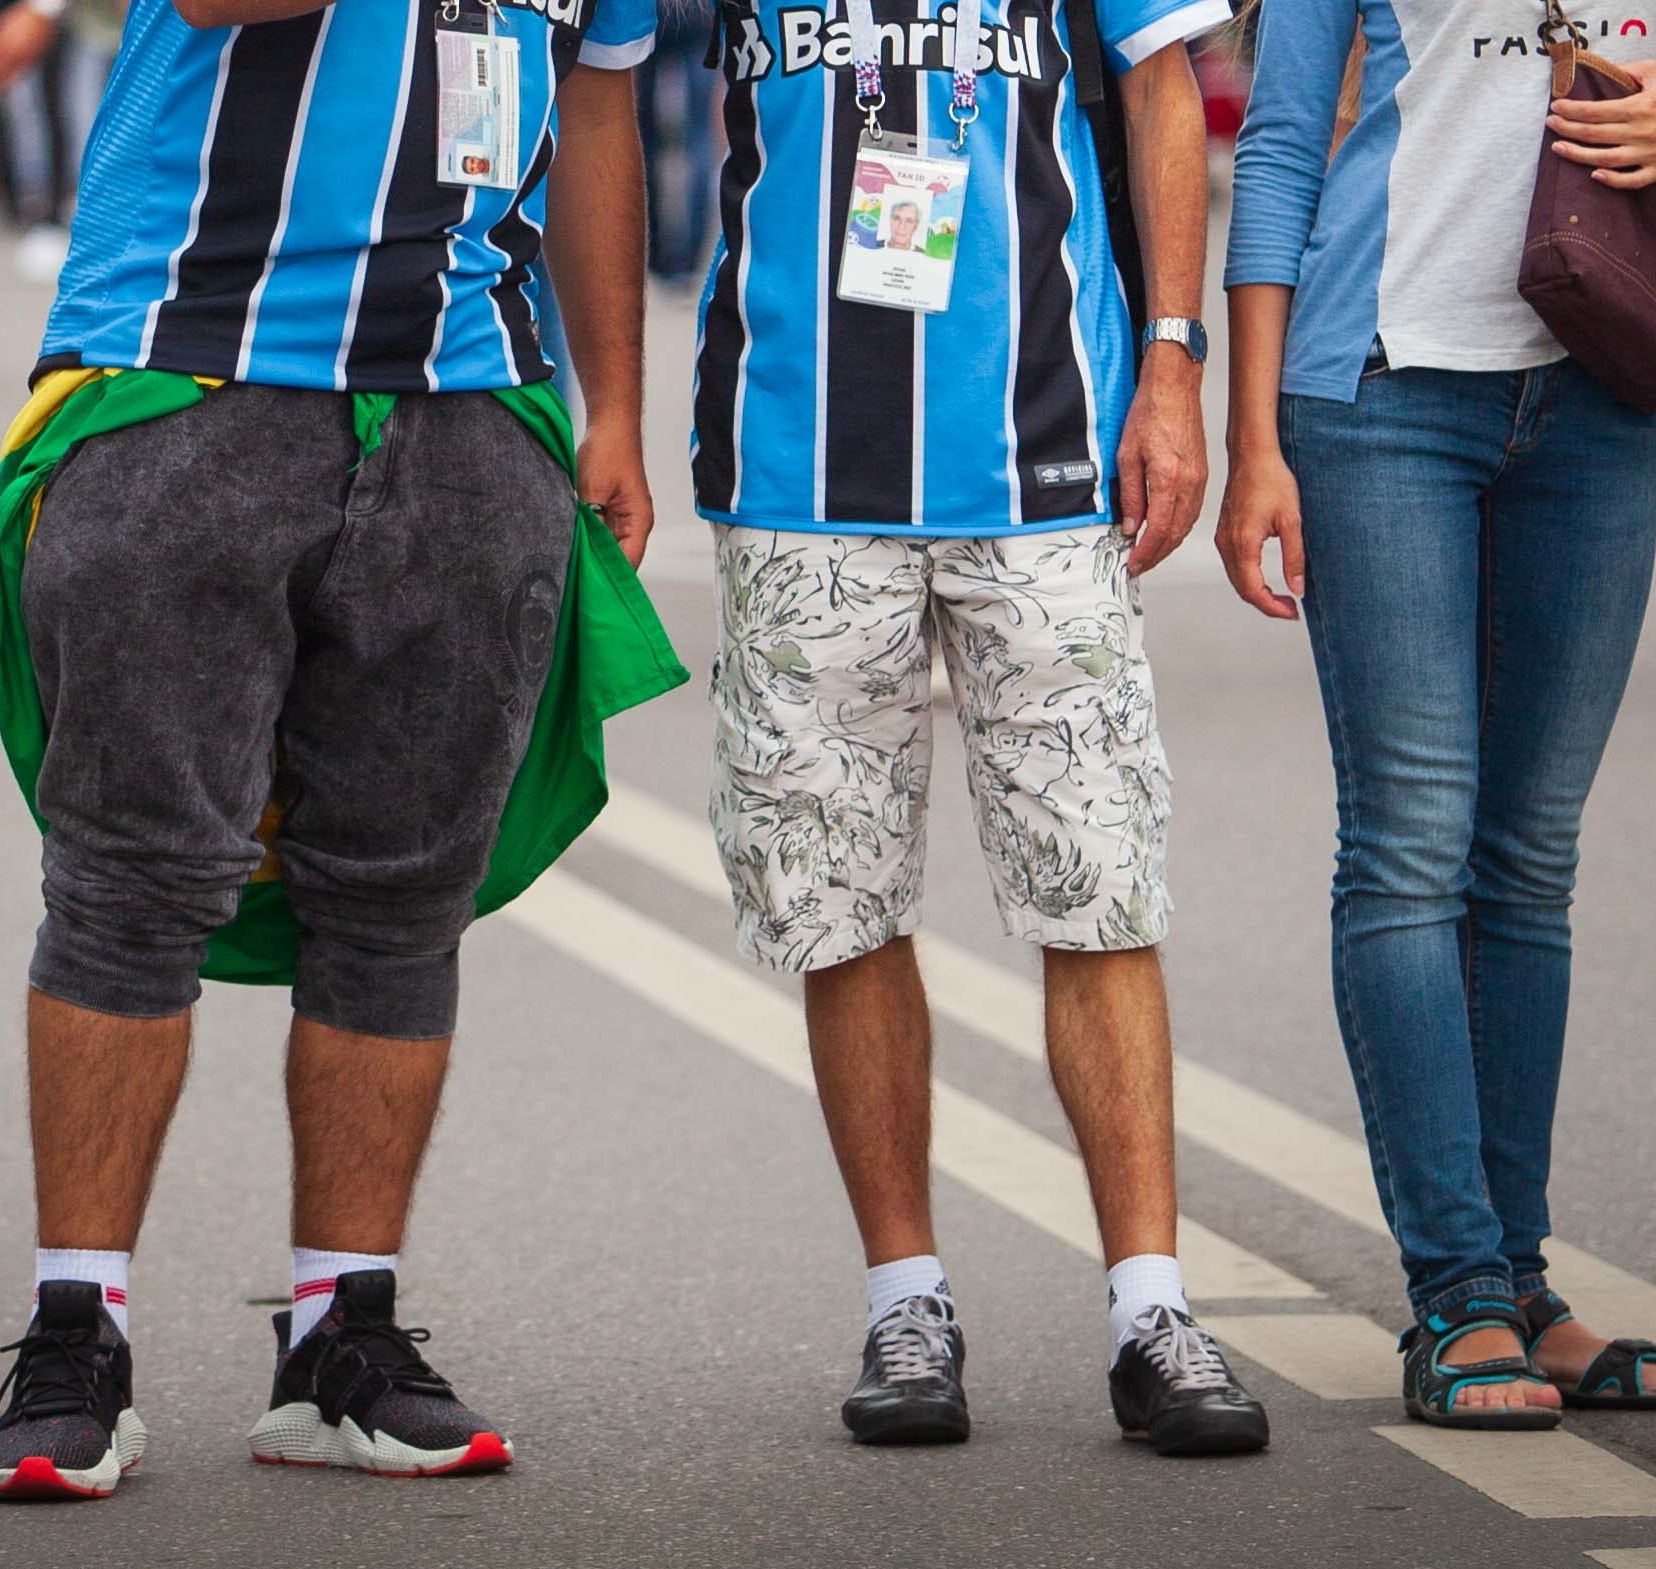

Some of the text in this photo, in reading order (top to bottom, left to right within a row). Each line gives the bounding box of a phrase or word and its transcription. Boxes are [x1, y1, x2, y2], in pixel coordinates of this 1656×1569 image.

[782, 6, 1042, 80] Banrisul
[897, 171, 913, 180] FAN
[915, 173, 925, 182] ID
